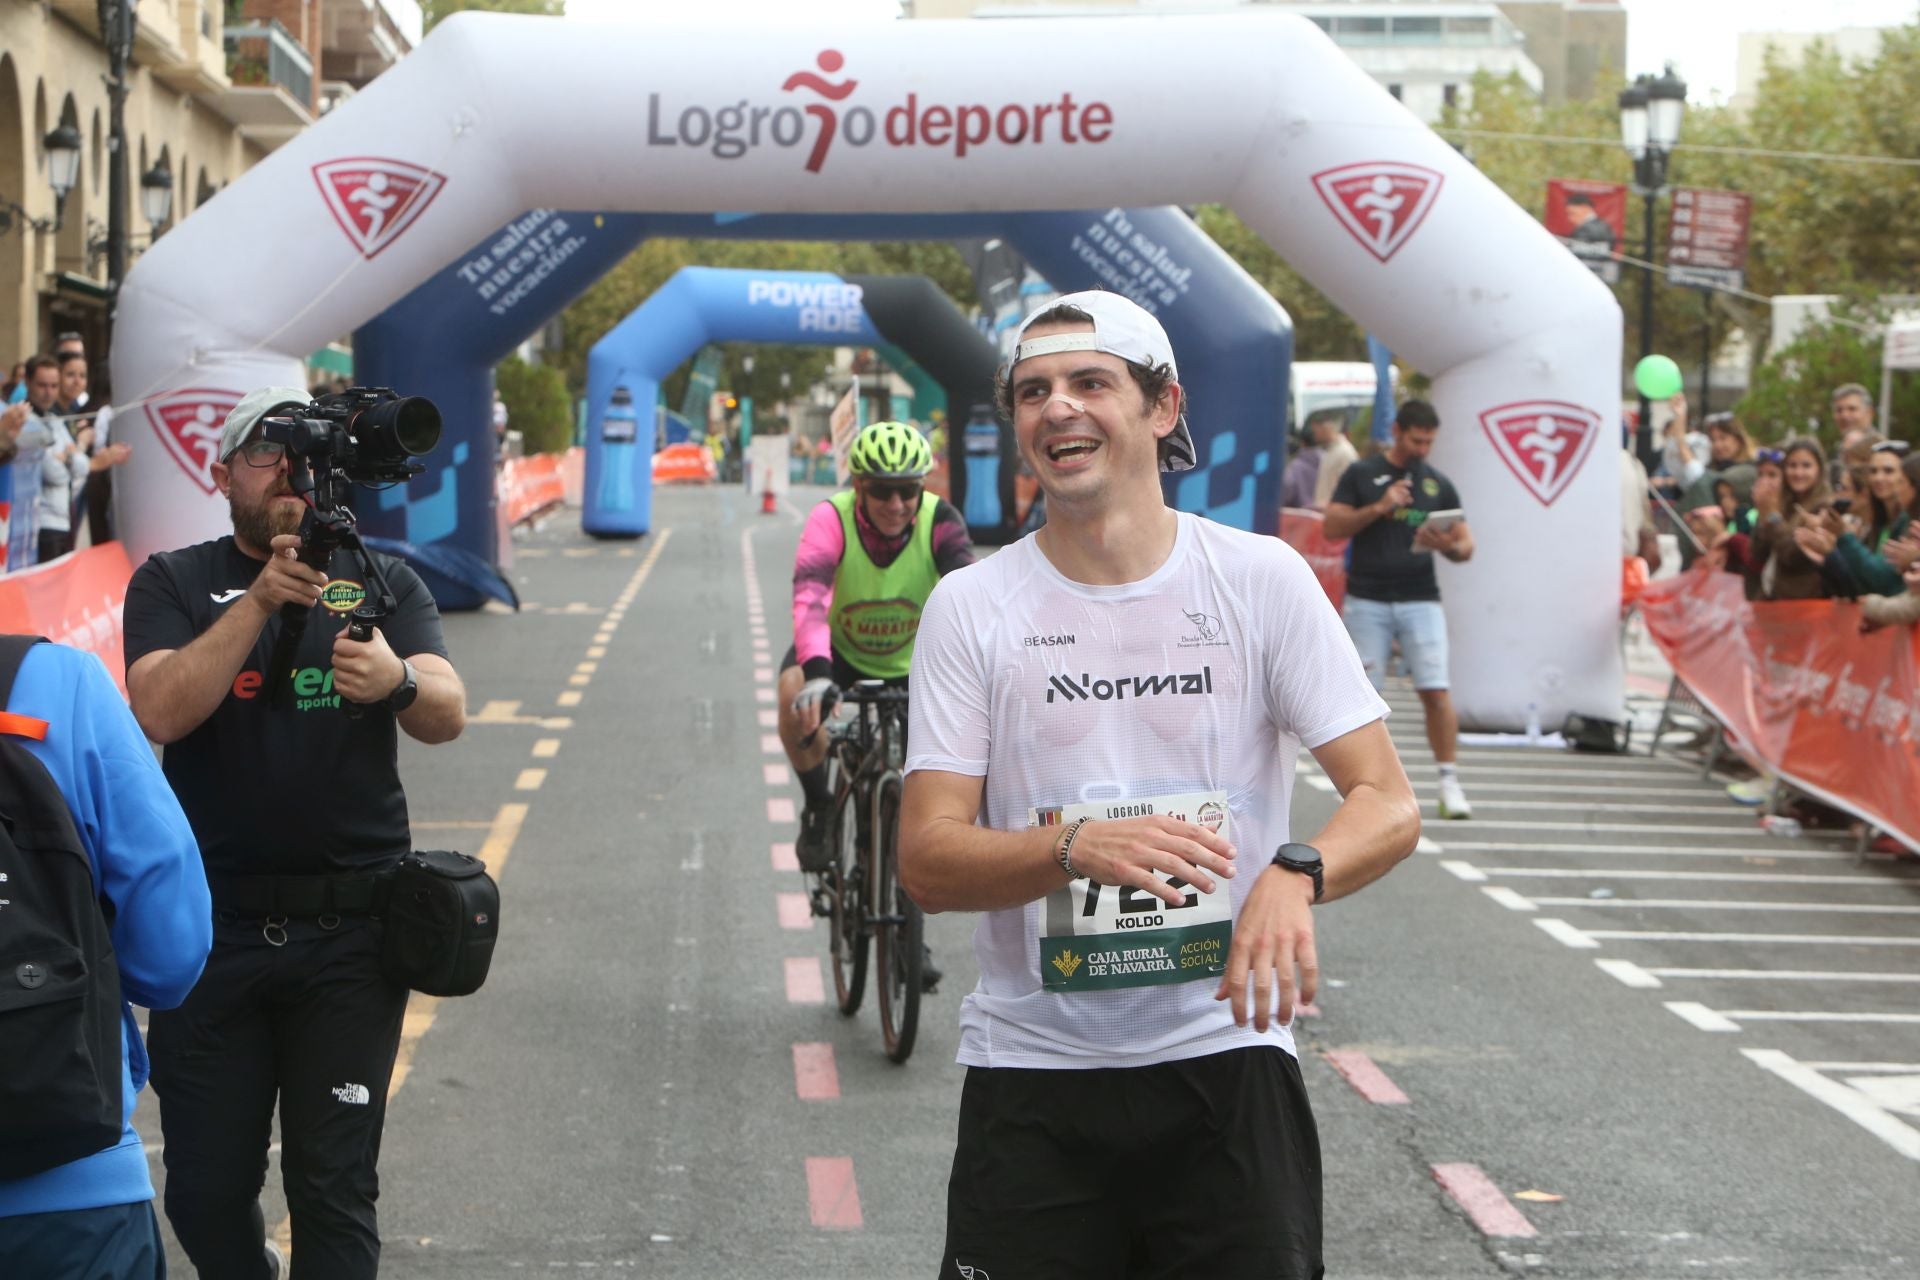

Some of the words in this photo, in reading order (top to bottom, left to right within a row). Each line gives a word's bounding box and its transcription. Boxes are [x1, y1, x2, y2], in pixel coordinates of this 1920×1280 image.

[885, 93, 1112, 157] deporte
[478, 218, 569, 299] nuestra
[1103, 207, 1133, 238] Tu
[1129, 233, 1192, 294] salud,
[456, 254, 494, 283] Tu
[1087, 222, 1177, 306] nuestra
[748, 279, 864, 306] POWER
[800, 307, 861, 332] ADE
[1024, 634, 1076, 647] BEASAIN
[1106, 803, 1154, 819] LOGROÑO
[1115, 915, 1164, 930] KOLDO
[1087, 950, 1121, 964] CAJA
[1122, 947, 1169, 961] RURAL
[1179, 939, 1221, 955] ACCIÓN
[1088, 964, 1108, 976] DE
[1111, 959, 1176, 975] NAVARRA
[1180, 955, 1221, 969] SOCIAL
[332, 1087, 358, 1098] NORTH
[345, 1082, 360, 1091] THE
[338, 1094, 359, 1104] FACE
